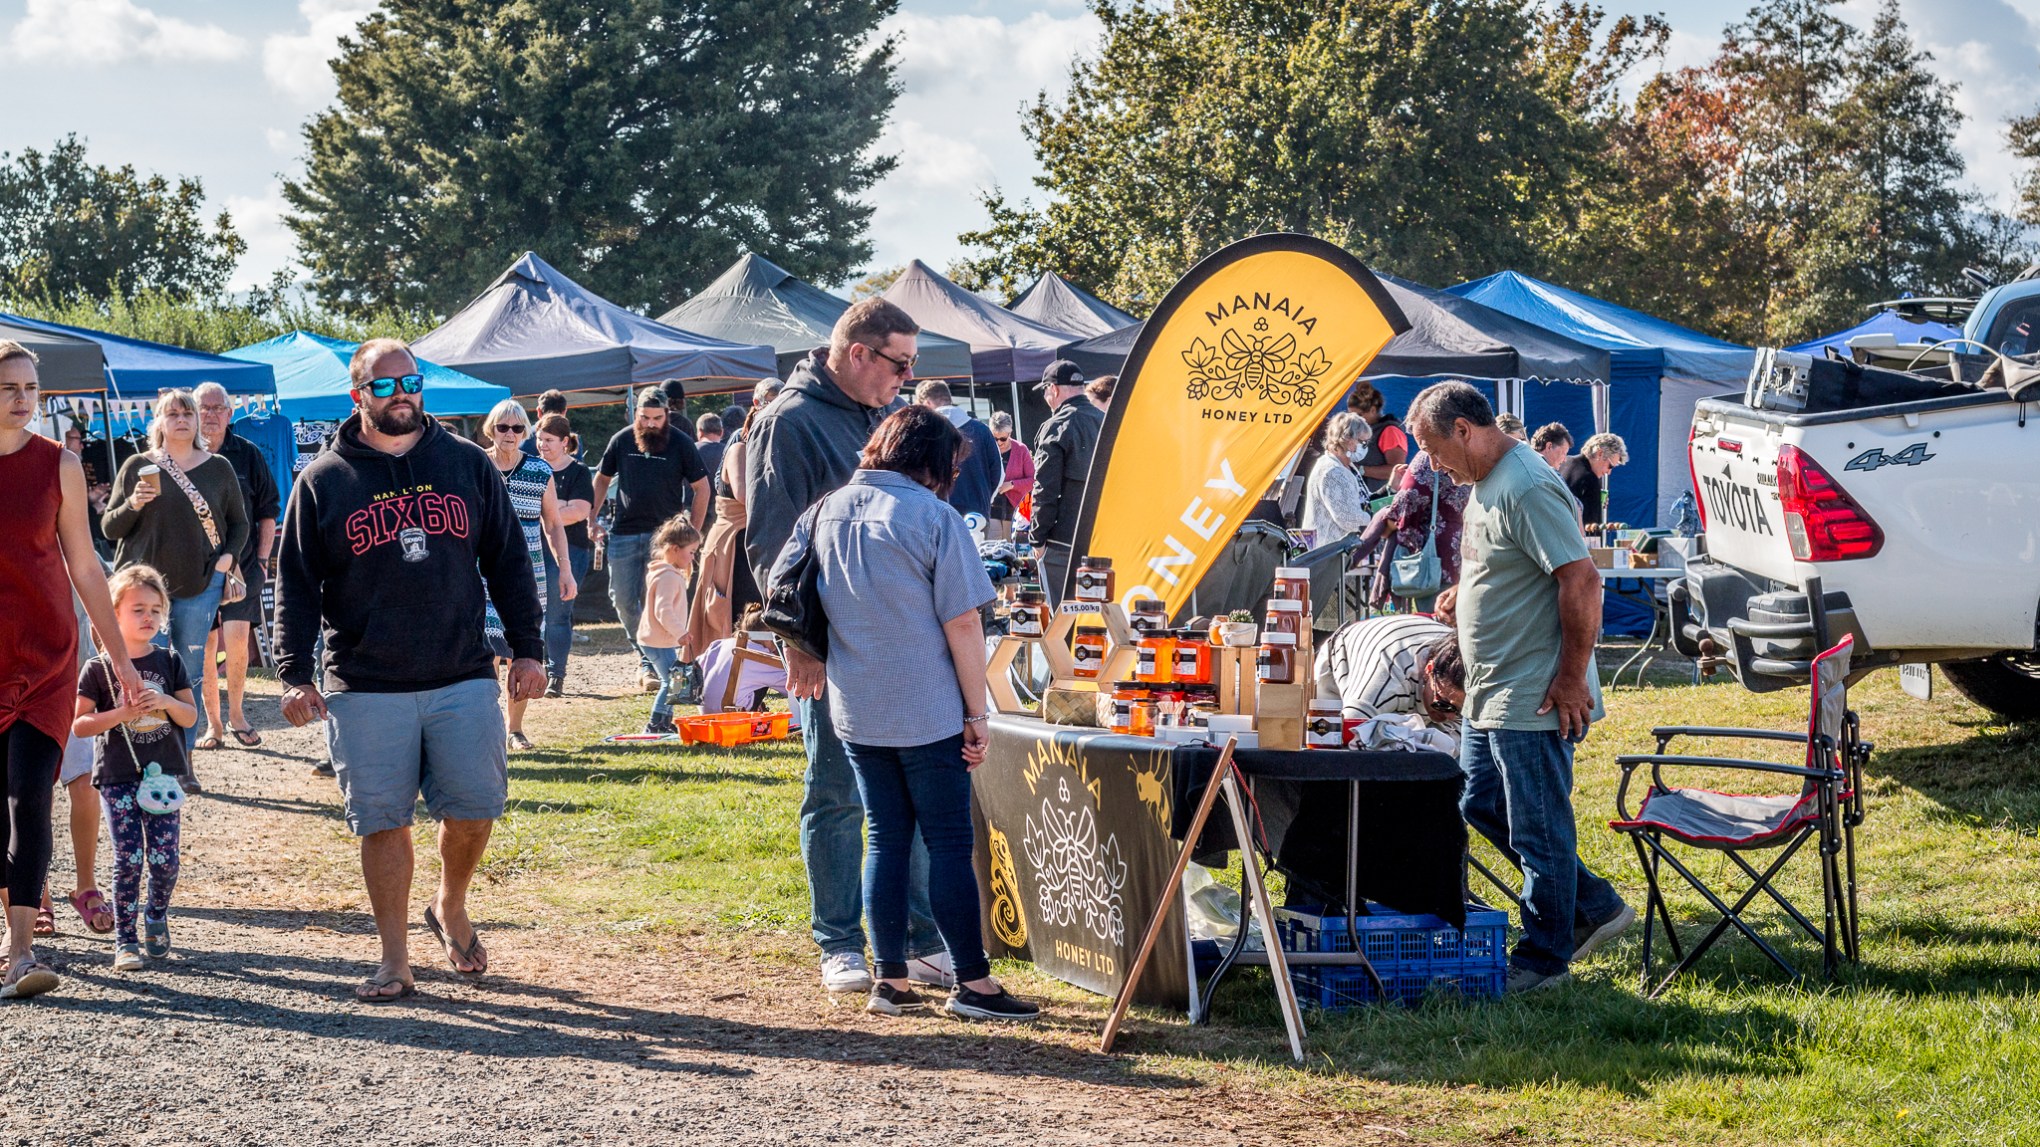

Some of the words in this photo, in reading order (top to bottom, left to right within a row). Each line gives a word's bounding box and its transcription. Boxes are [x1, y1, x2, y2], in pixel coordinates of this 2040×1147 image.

[1205, 291, 1317, 336] MANAIA
[1201, 408, 1258, 422] HONEY
[1264, 412, 1293, 424] LTD
[345, 492, 469, 556] SIX60
[1702, 474, 1774, 537] TOYOTA
[1023, 737, 1101, 812] MANAIA
[1055, 939, 1091, 968] HONEY
[1094, 952, 1115, 976] LTD
